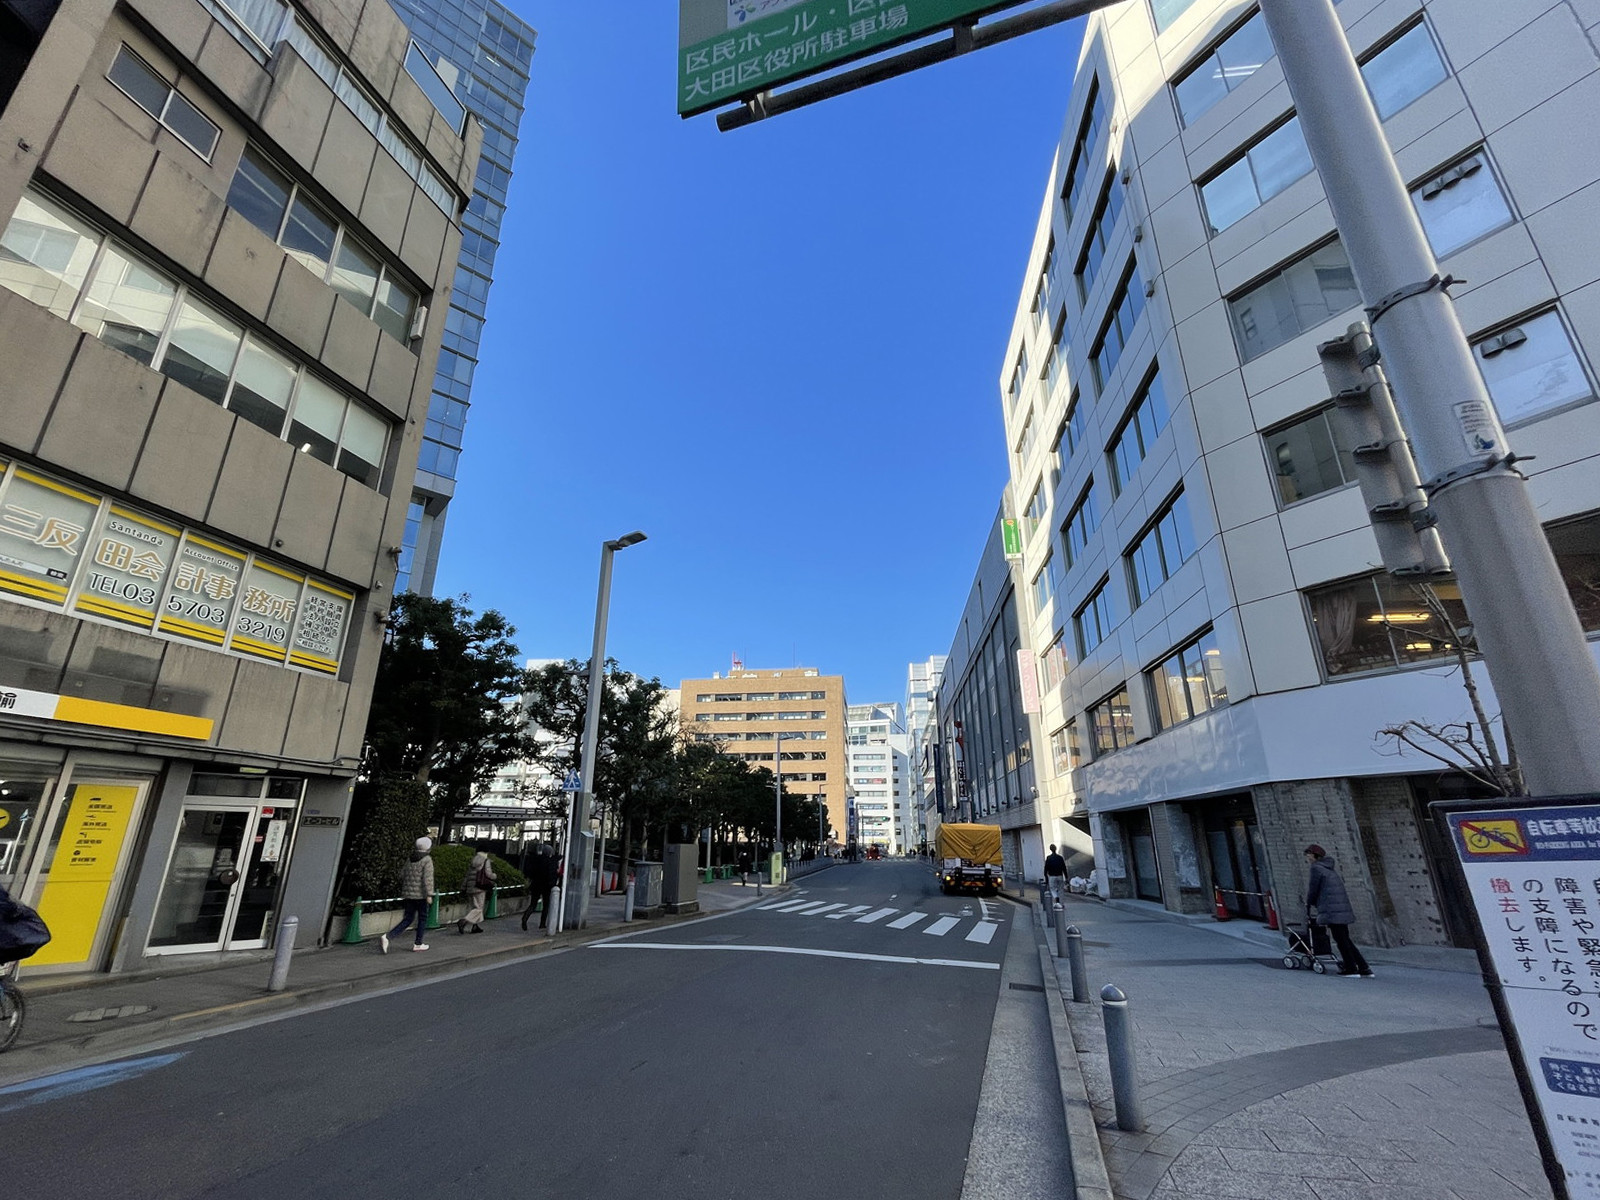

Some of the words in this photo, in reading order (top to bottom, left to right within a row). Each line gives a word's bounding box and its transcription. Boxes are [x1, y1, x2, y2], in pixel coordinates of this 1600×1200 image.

[685, 5, 909, 101] 大田区役所駐車場
[110, 521, 164, 546] Santanda
[184, 547, 216, 563] Account
[217, 557, 240, 571] Office
[167, 595, 226, 625] 5703
[238, 617, 286, 642] 3219
[1526, 816, 1600, 836] 自転車等放
[1489, 877, 1547, 983] 撤去します。
[1523, 877, 1598, 1040] の支障になるので
